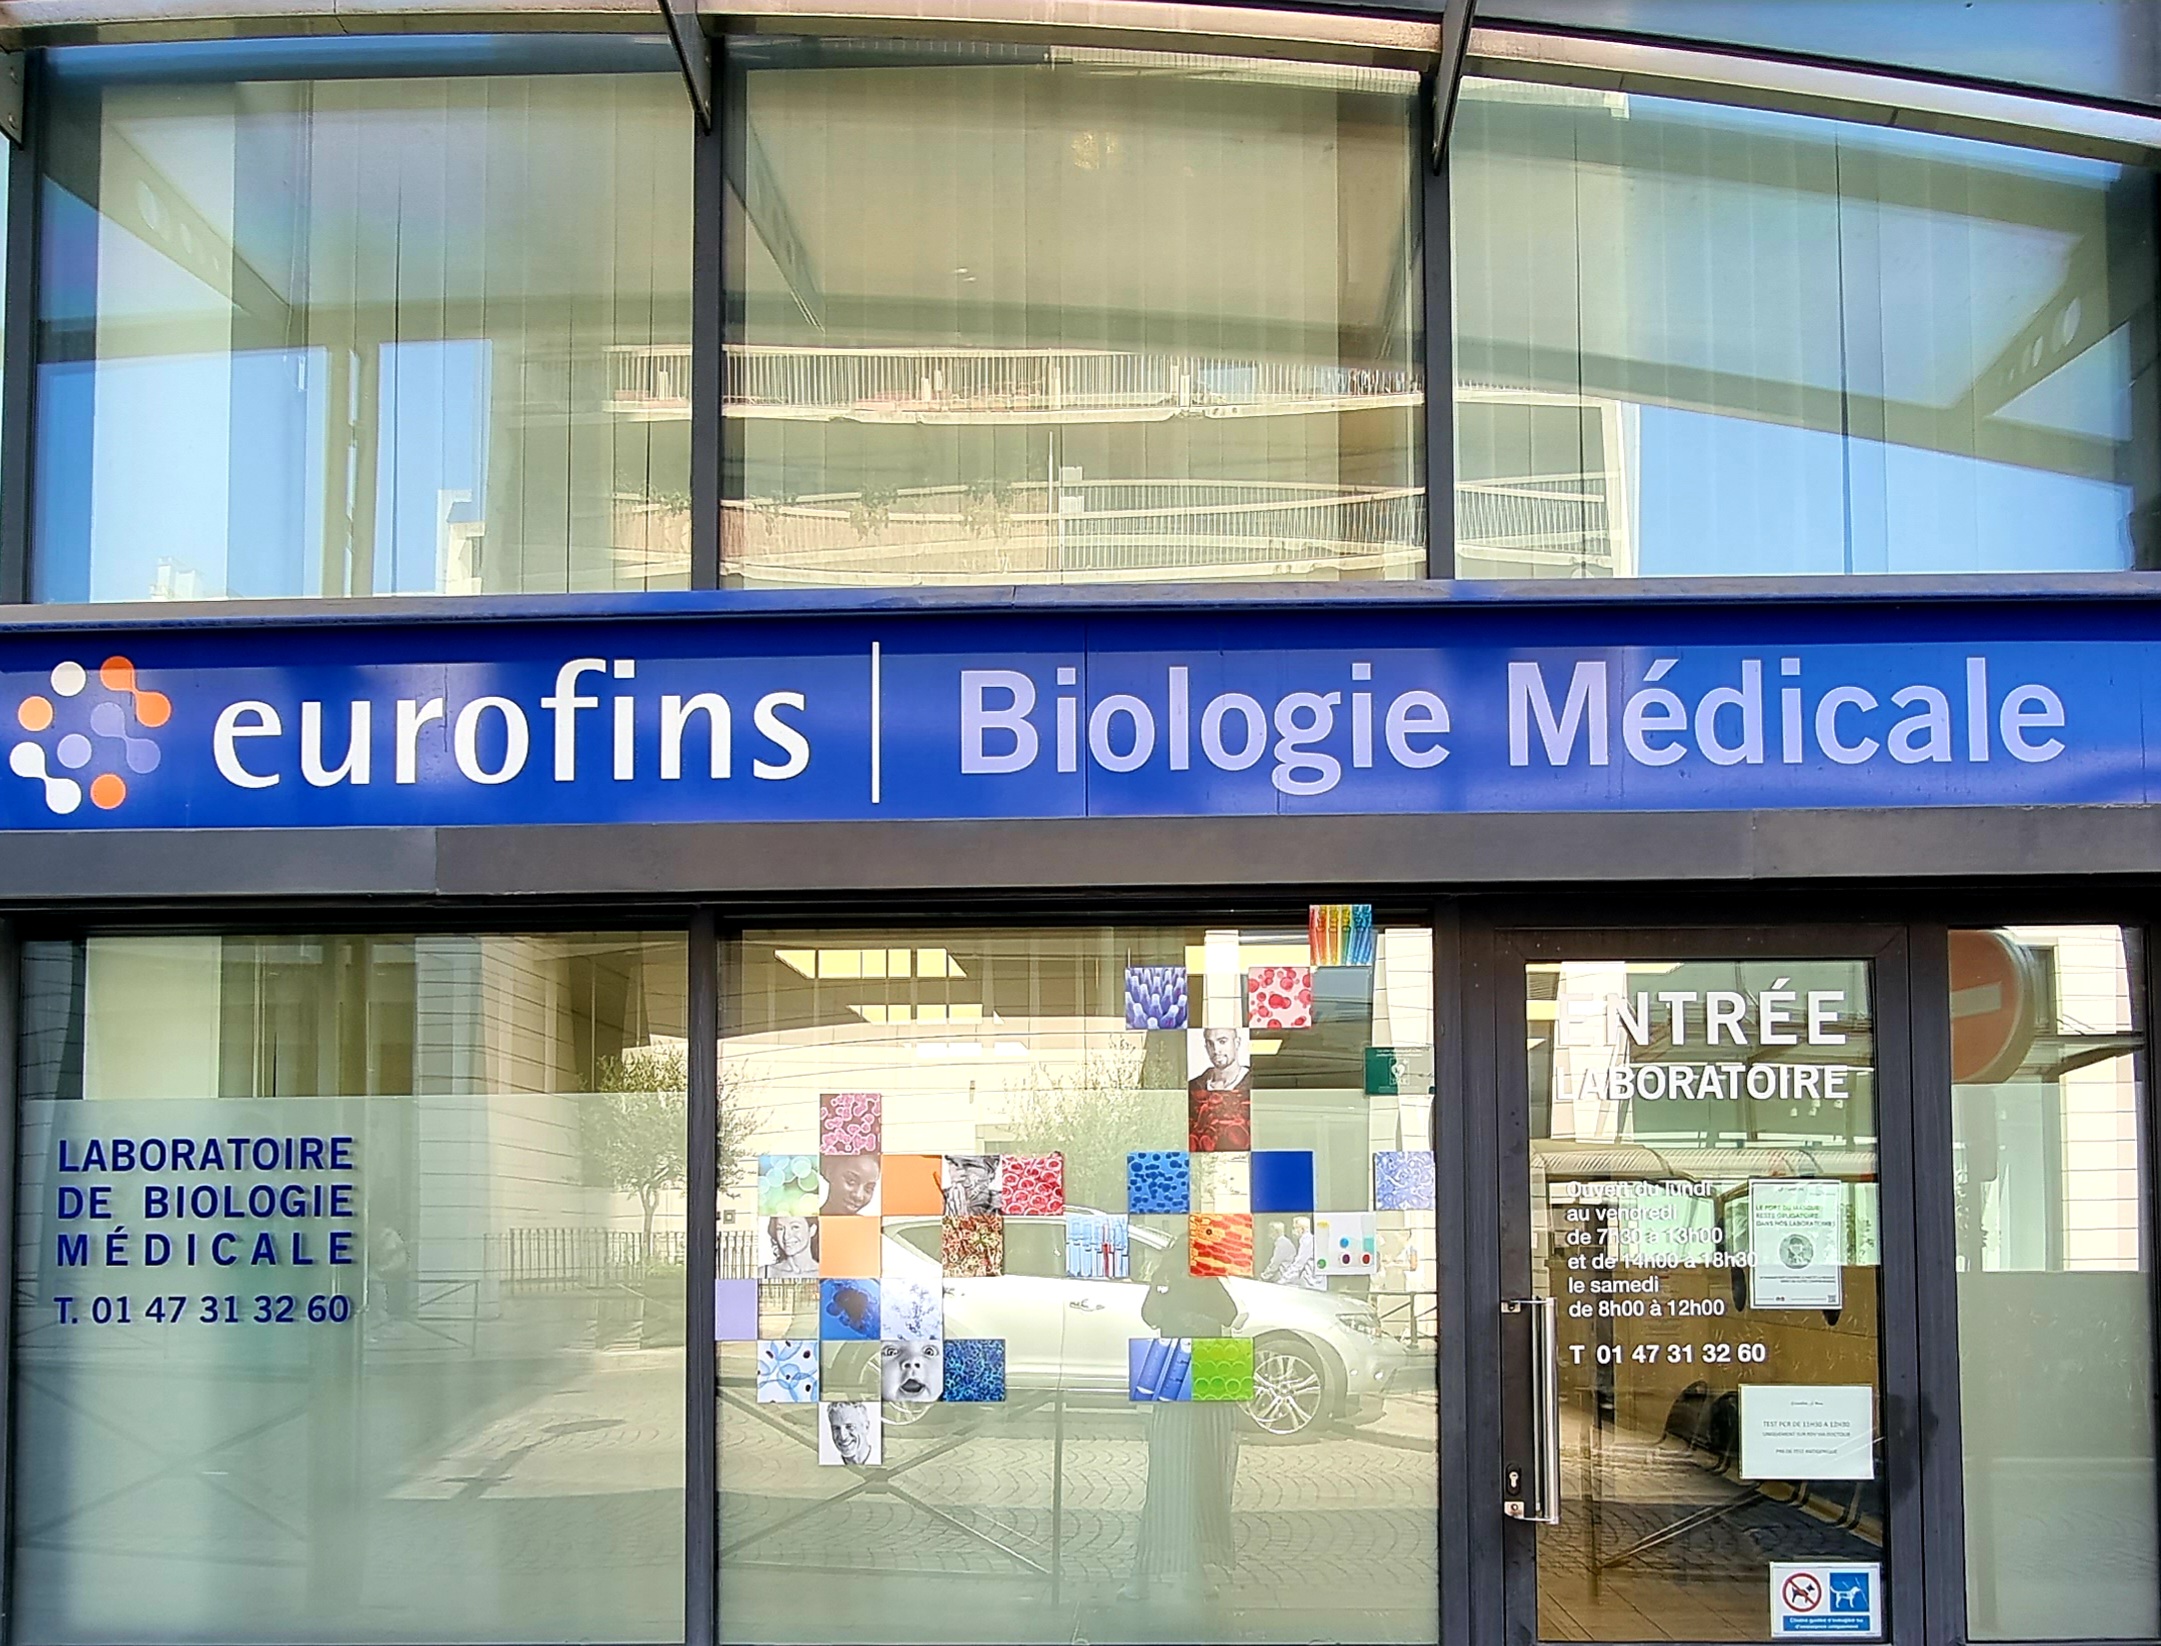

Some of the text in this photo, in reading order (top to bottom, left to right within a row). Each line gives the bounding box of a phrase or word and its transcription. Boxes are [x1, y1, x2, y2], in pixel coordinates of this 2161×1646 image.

[212, 657, 2066, 796] eurofins Biologie Médicale
[1556, 977, 1847, 1046] ENTRÉE
[1555, 1064, 1850, 1101] LABORATOIRE
[58, 1136, 354, 1172] LABORATOIRE
[57, 1184, 354, 1220] DE BIOLOGIE
[1566, 1180, 1711, 1198] Ouvert du lundi
[1566, 1204, 1678, 1222] au vendredi
[56, 1225, 353, 1267] MÉDICALE
[1566, 1229, 1592, 1245] de
[1596, 1228, 1643, 1245] 7h30
[1667, 1227, 1723, 1244] 13h00
[1567, 1255, 1587, 1270] et
[1591, 1253, 1617, 1270] de
[1623, 1252, 1679, 1269] 14h00
[1703, 1251, 1758, 1269] 18h30
[1568, 1275, 1659, 1294] le samedi
[53, 1294, 350, 1325] T. 01 47 31 32 60
[1568, 1299, 1725, 1317] de 8h00 à 12h00
[1568, 1343, 1766, 1364] T 01 47 31 32 60
